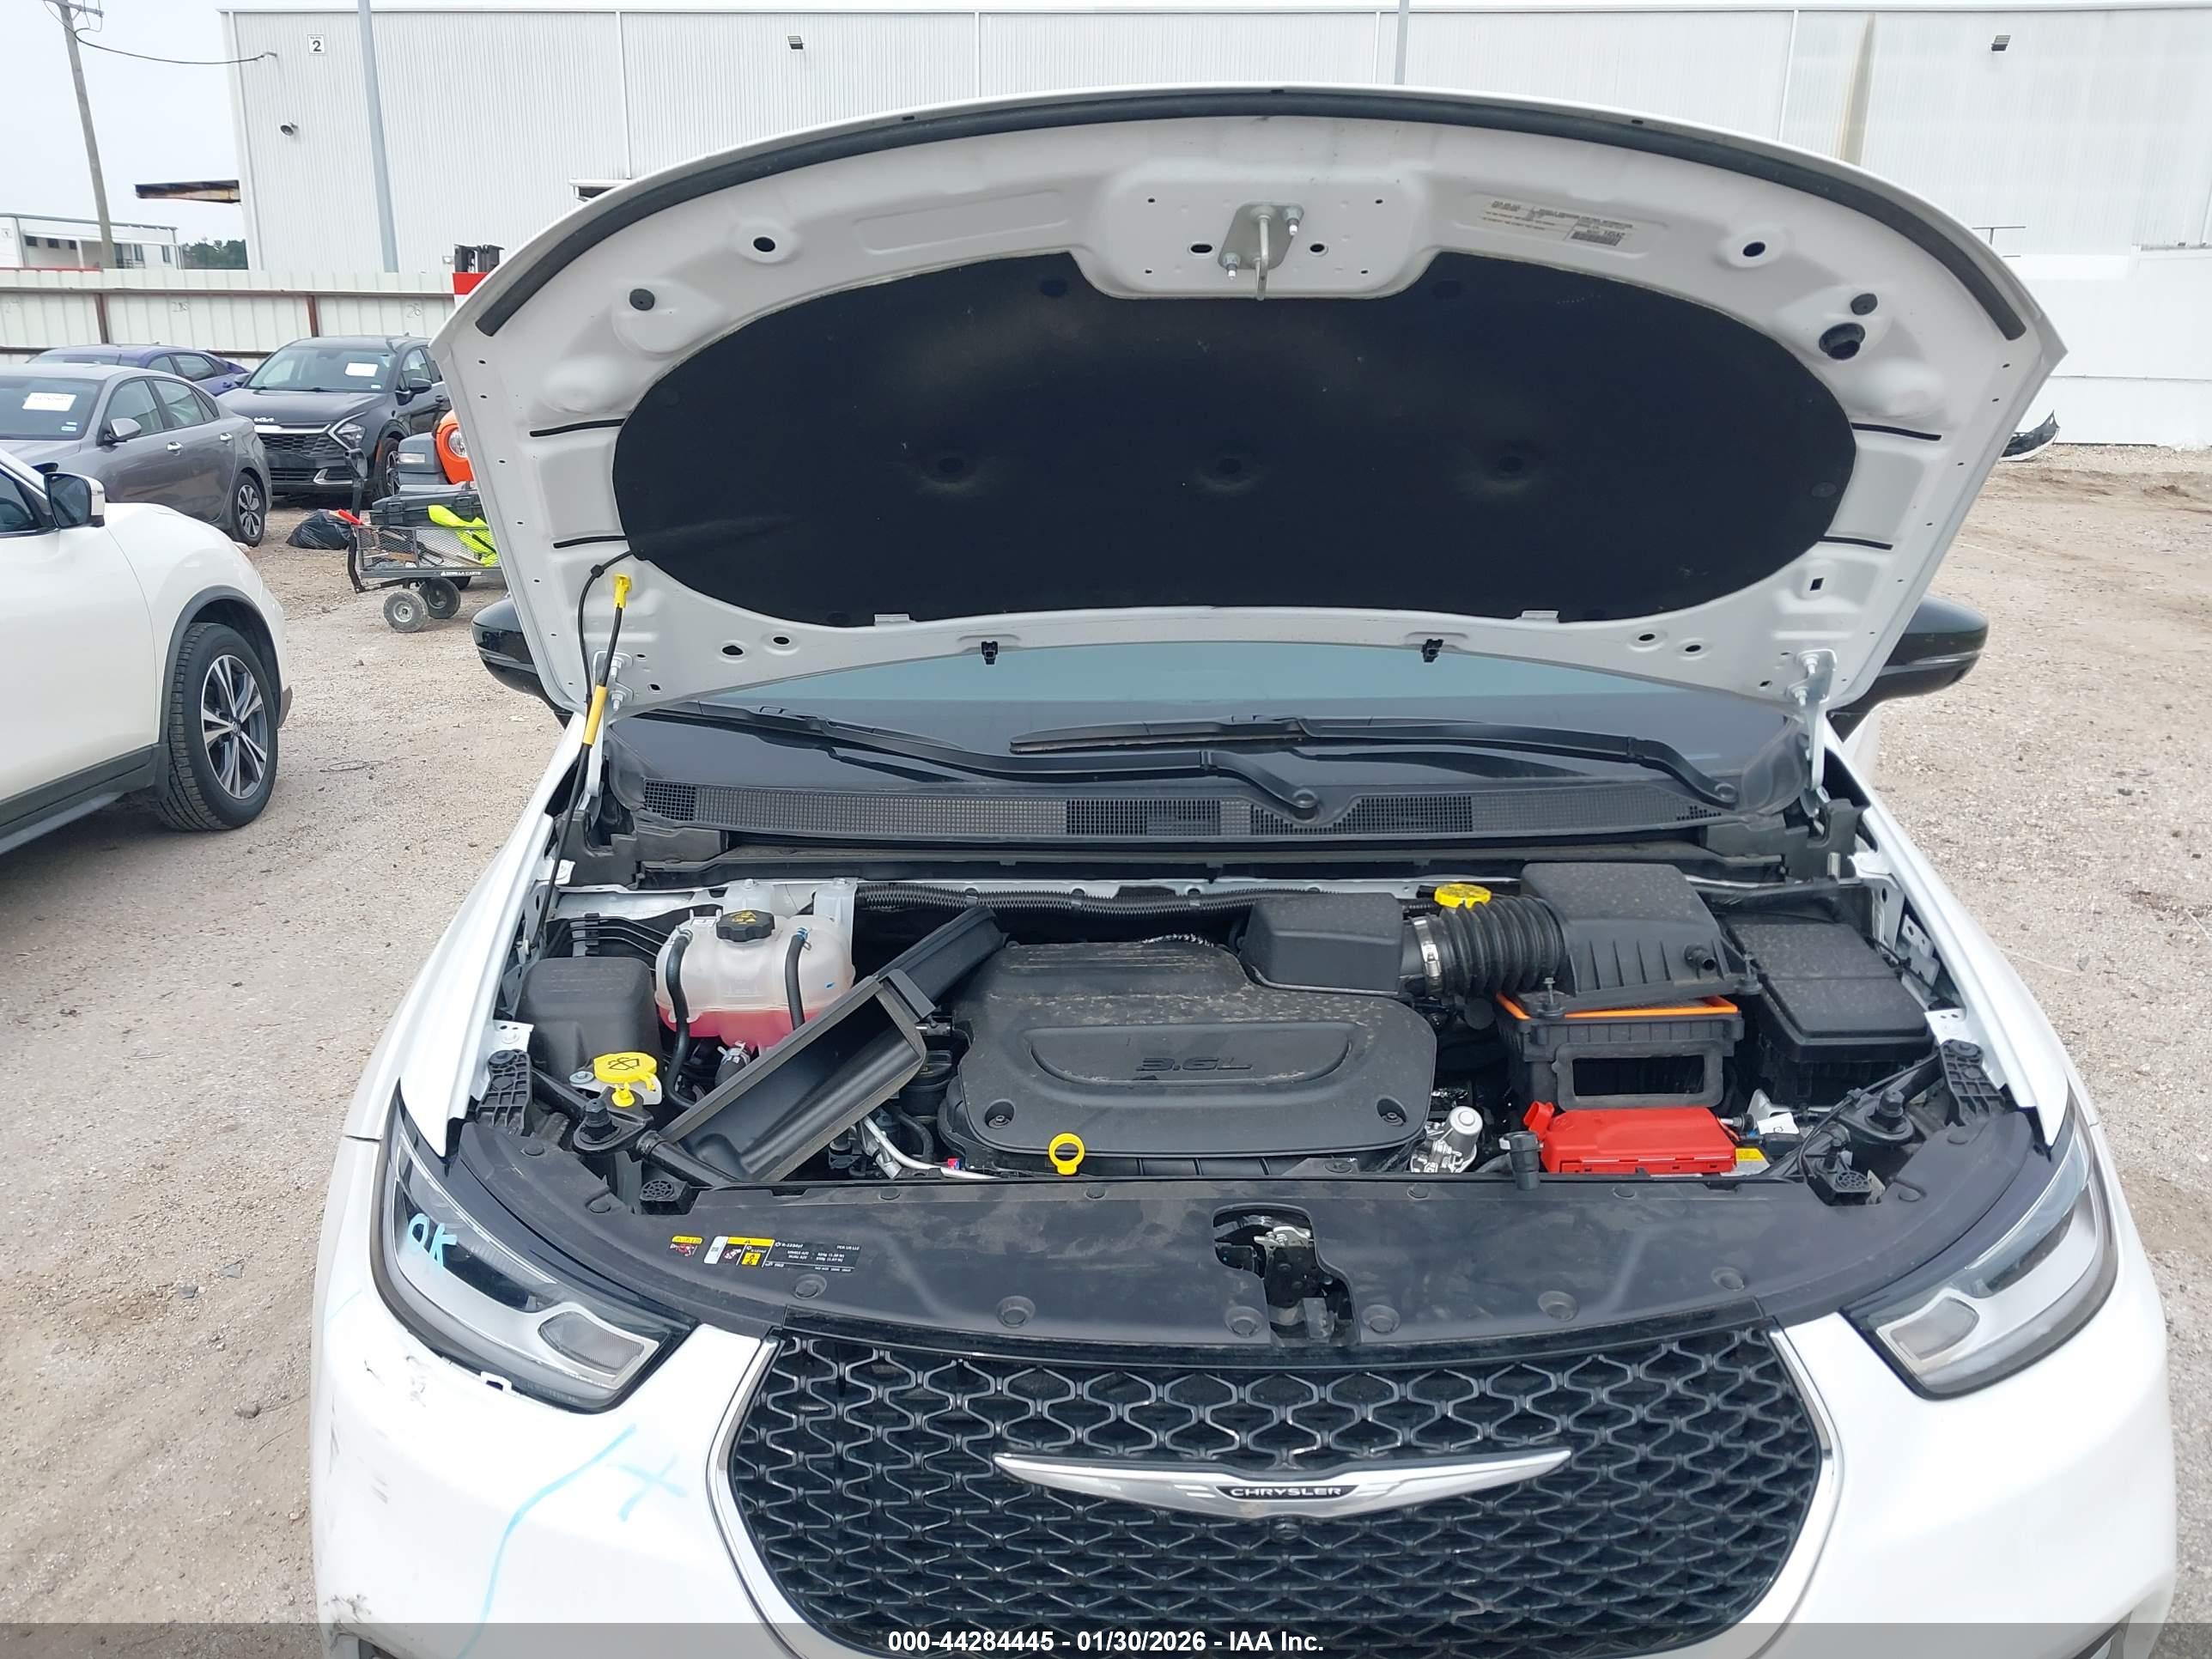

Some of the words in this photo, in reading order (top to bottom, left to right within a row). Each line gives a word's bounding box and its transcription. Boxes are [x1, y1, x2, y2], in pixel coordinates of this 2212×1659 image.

[313, 40, 322, 52] 2
[407, 1212, 458, 1267] OK
[1230, 1486, 1342, 1498] CHRYSLER
